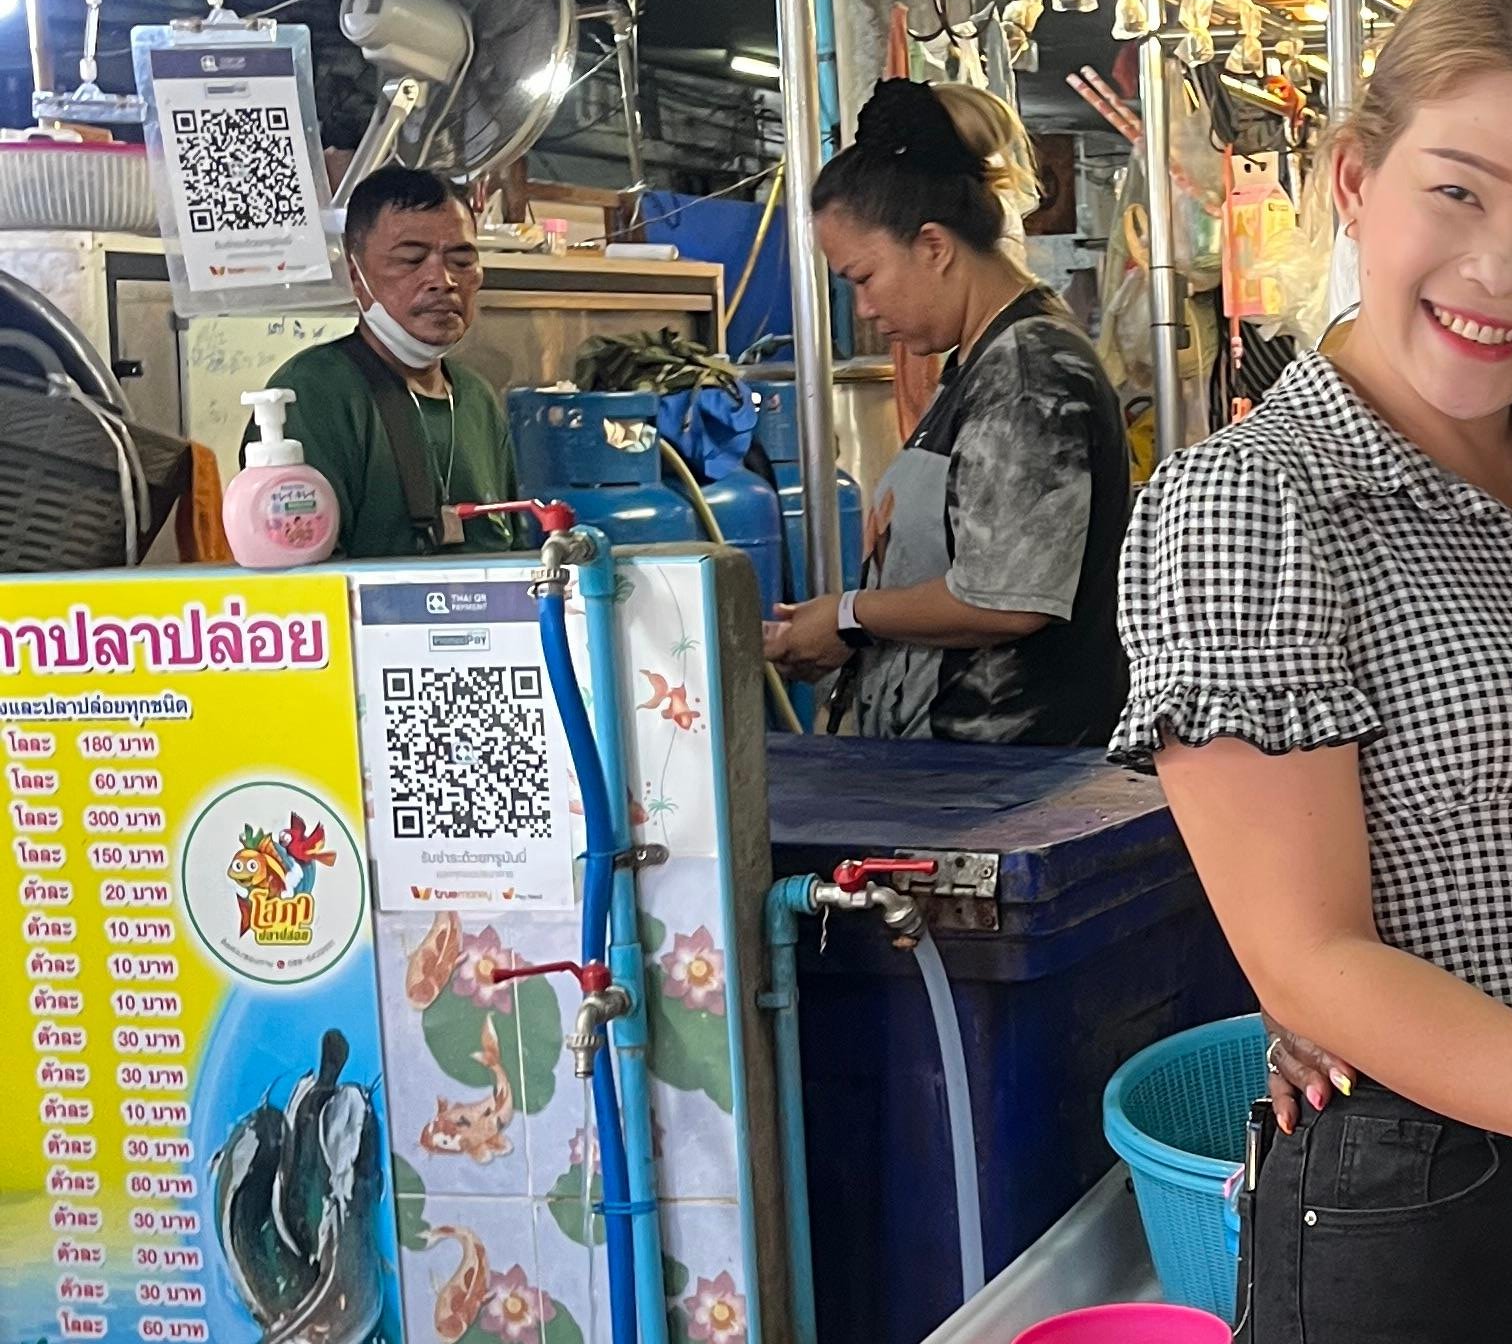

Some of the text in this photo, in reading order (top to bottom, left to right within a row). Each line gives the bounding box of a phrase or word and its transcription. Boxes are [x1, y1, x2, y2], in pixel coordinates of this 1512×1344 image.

[83, 736, 113, 753] 180
[119, 737, 155, 752] บาท
[95, 773, 116, 789] 60
[123, 775, 158, 789] บาท
[88, 810, 119, 826] 300
[126, 812, 161, 826] บาท
[93, 847, 122, 863] 150
[129, 849, 164, 864] บาท
[24, 879, 168, 901] ตัวละ 20 บาท
[28, 916, 171, 937] ตัวละ 10 บาท
[31, 953, 174, 974] ตัวละ 10 บาท
[35, 989, 177, 1011] ตัวละ 10 บาท
[38, 1025, 180, 1047] ตัวละ 30 บาท
[42, 1062, 184, 1084] ตัวละ 30 บาท
[45, 1098, 187, 1120] ตัวละ 10 บาท
[48, 1134, 190, 1157] ตัวละ 30 บาท
[52, 1170, 95, 1190] ตัวละ
[158, 1179, 193, 1193] บาท
[55, 1206, 196, 1229] ตัวละ 30 บาท
[58, 1242, 199, 1265] ตัวละ 30 บาท
[61, 1277, 202, 1301] ตัวละ 30 บาท
[170, 1323, 204, 1338] บาท
